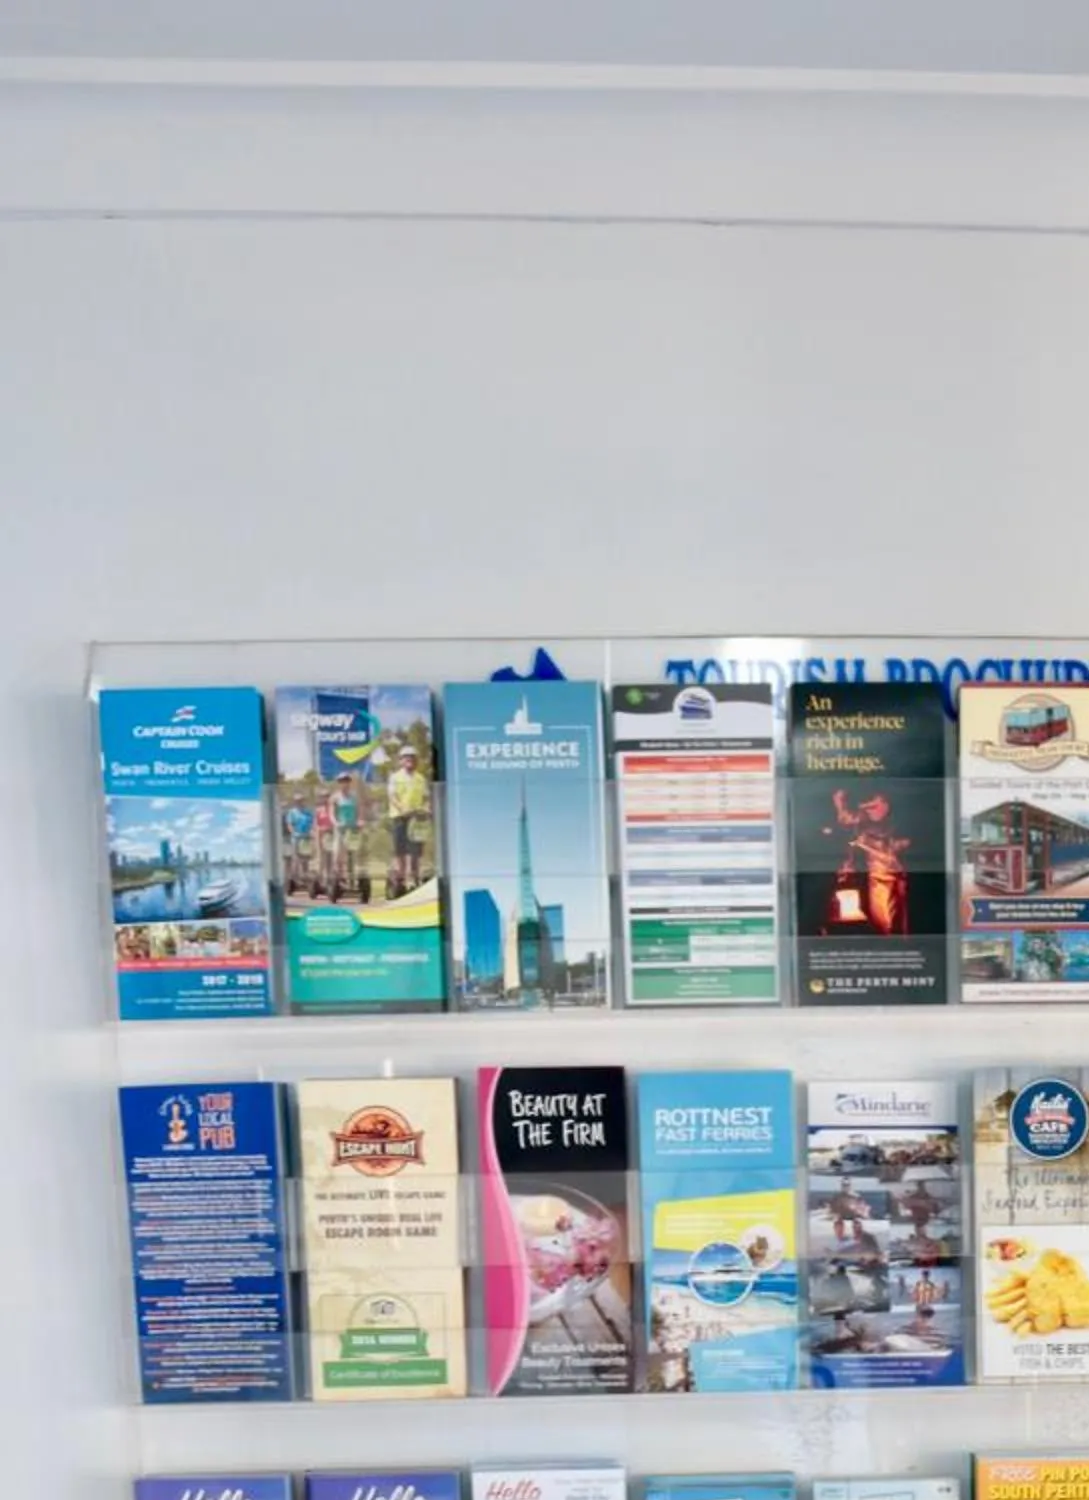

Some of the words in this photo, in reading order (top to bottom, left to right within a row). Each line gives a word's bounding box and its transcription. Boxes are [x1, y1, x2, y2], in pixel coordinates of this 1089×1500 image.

[806, 694, 832, 711] An
[805, 713, 906, 732] experience
[464, 741, 580, 759] EXPERIENCE
[806, 733, 842, 750] rich
[843, 735, 864, 750] in
[111, 761, 150, 777] Swan
[153, 760, 192, 775] River
[195, 759, 251, 775] Cruises
[806, 752, 886, 772] heritage.
[508, 1091, 577, 1118] BEAUTY
[582, 1092, 607, 1117] AT
[198, 1111, 235, 1126] LOCAL
[654, 1106, 774, 1126] ROTTNEST
[199, 1126, 236, 1150] PUB
[512, 1119, 553, 1149] THE
[562, 1119, 607, 1147] FIRM
[654, 1127, 697, 1142] FAST
[701, 1126, 774, 1142] FERRIES
[325, 1227, 364, 1239] ESCAPE
[1039, 1465, 1066, 1483] PIN
[988, 1482, 1042, 1500] SOUTH
